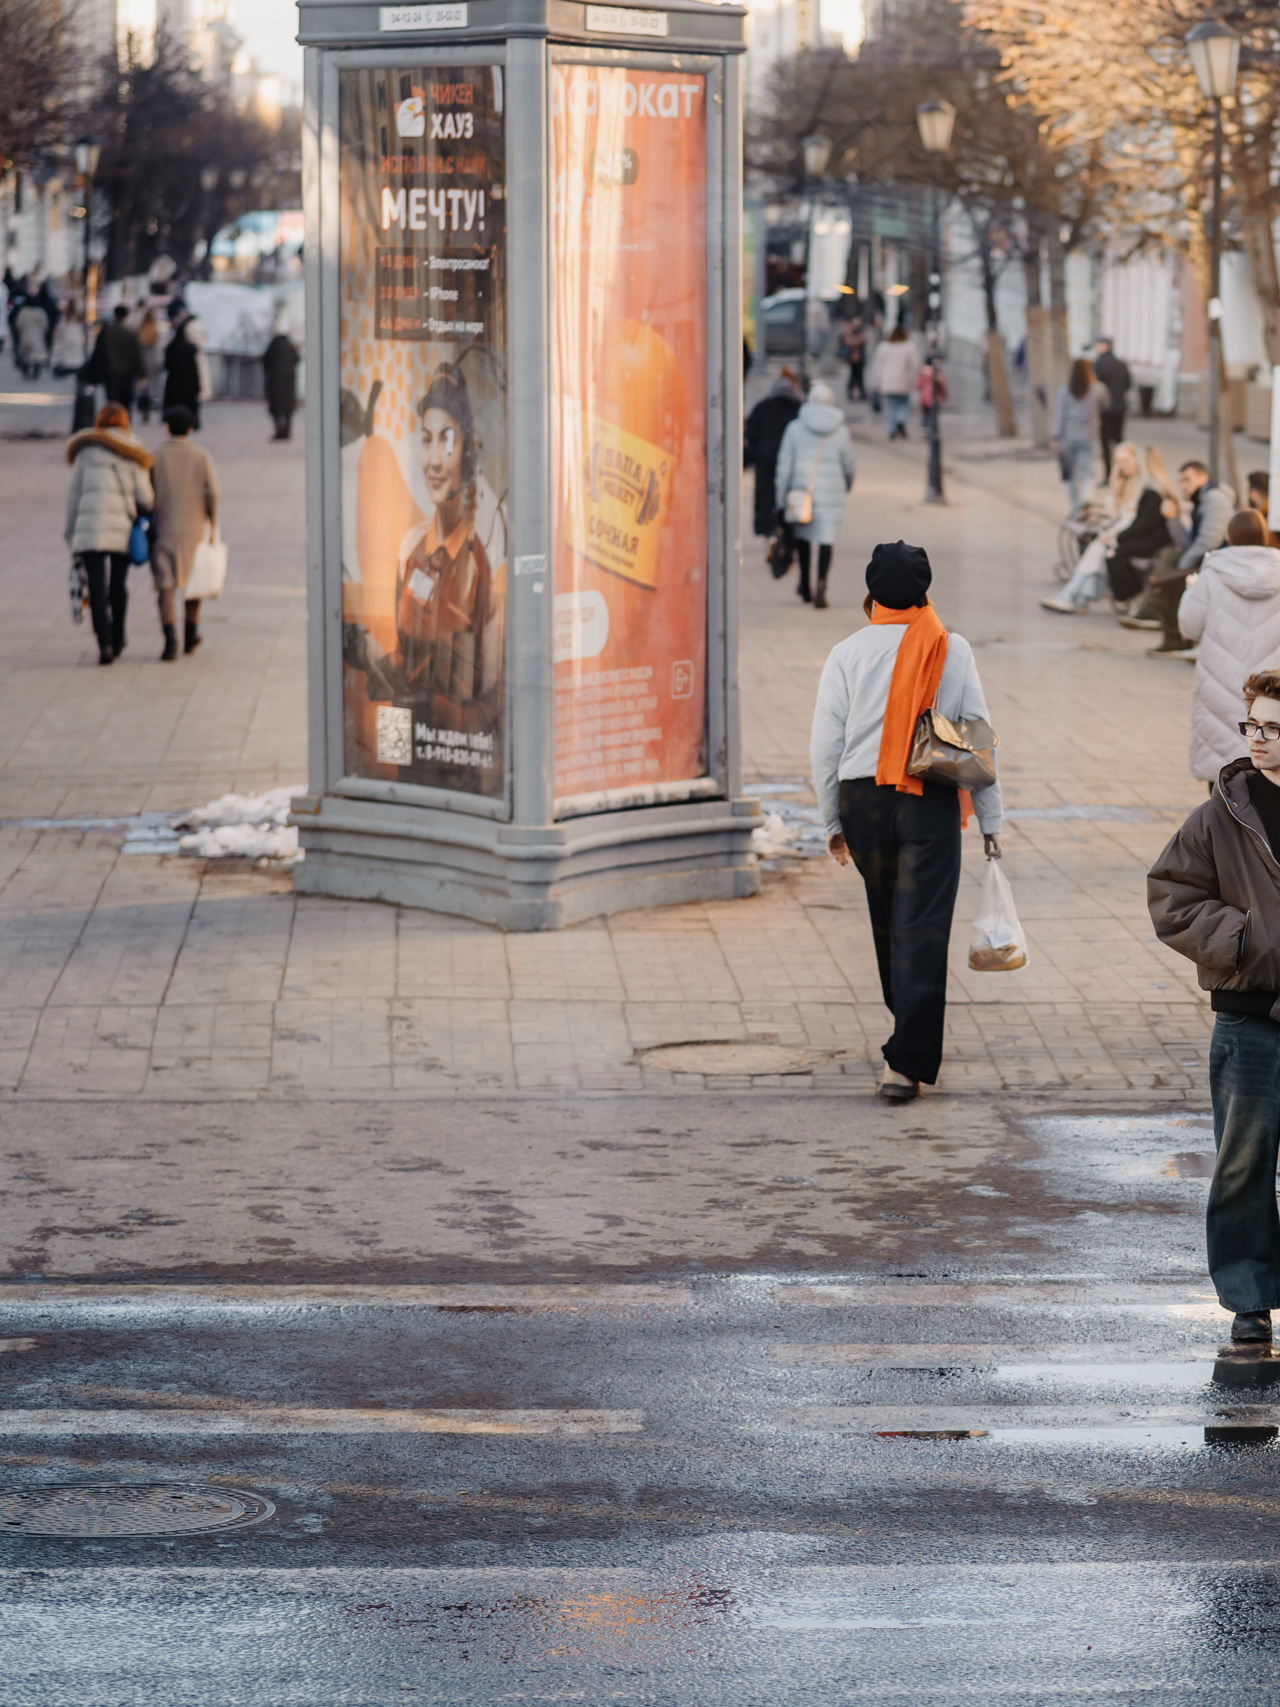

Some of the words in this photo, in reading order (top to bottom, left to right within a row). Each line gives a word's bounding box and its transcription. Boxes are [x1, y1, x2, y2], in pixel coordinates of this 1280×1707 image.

[430, 112, 474, 140] ХАУЗ
[381, 186, 486, 232] МЕЧТУ!
[674, 666, 690, 693] 6+
[414, 722, 436, 742] Мы
